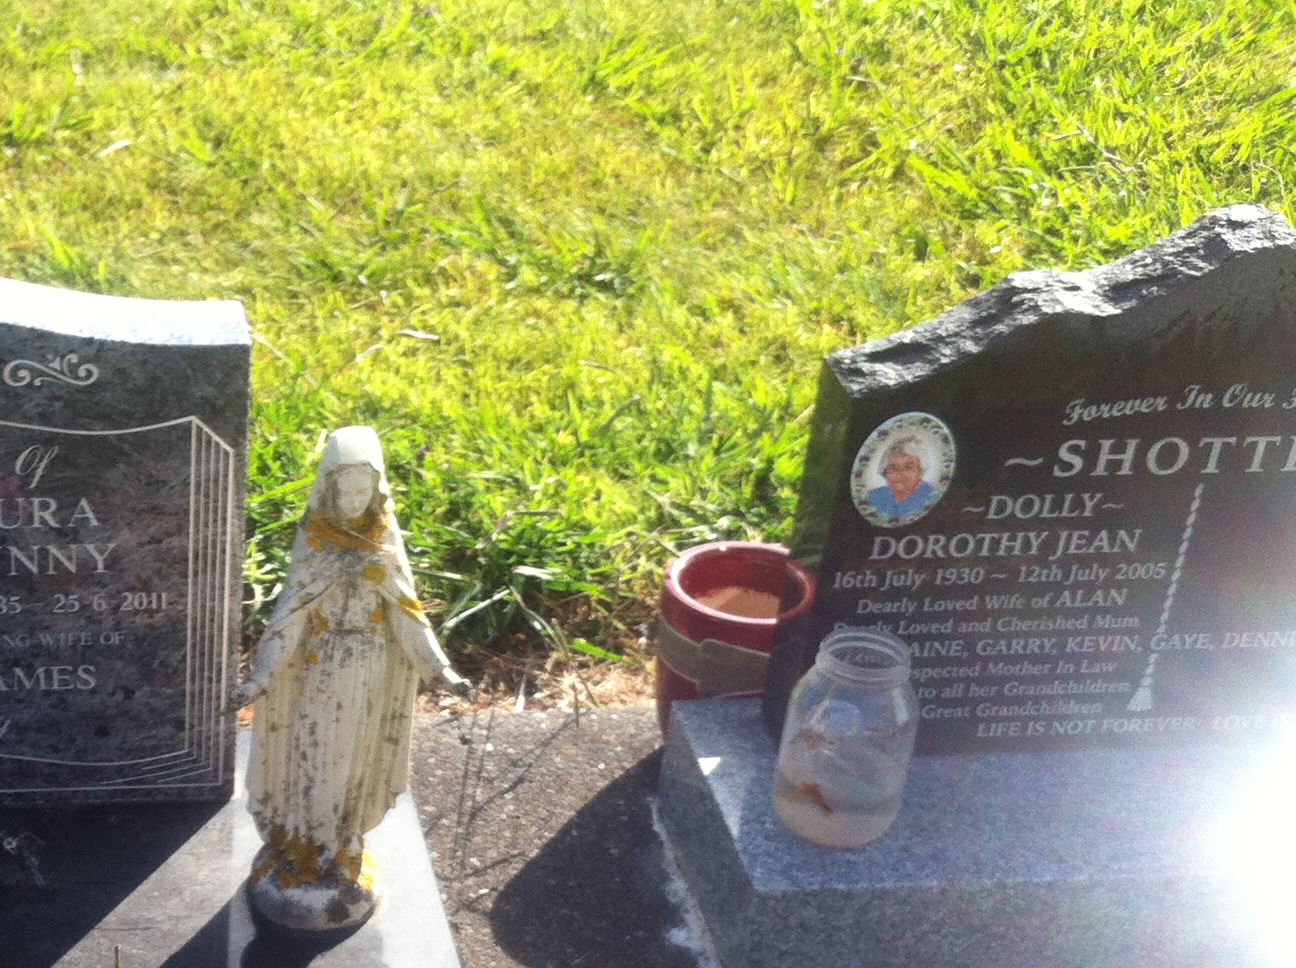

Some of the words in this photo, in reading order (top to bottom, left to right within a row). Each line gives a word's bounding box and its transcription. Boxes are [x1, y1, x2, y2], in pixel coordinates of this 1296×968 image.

[1062, 397, 1167, 426] Forever
[1176, 384, 1213, 410] In
[1222, 383, 1277, 409] Our
[15, 444, 59, 488] Of
[869, 531, 1049, 560] DOROTHY
[1048, 529, 1142, 560] JEAN
[832, 571, 877, 588] 16th
[879, 569, 925, 591] July
[934, 566, 984, 586] 1930
[1017, 565, 1063, 583] 12th
[1064, 562, 1110, 585] July
[1115, 562, 1167, 580] 2005
[857, 598, 918, 616] Dearly
[923, 595, 978, 611] Loved
[985, 593, 1024, 610] Wife
[1031, 591, 1054, 608] of
[1053, 588, 1128, 607] ALAN
[898, 618, 954, 634] Loved
[958, 617, 992, 634] and
[997, 615, 1088, 632] Cherished
[1092, 614, 1140, 629] Mum
[38, 632, 93, 646] WIFE
[99, 631, 125, 645] OF
[911, 666, 981, 683] spected
[985, 661, 1051, 677] Mother
[1080, 658, 1118, 674] Law
[969, 681, 999, 698] her
[1004, 678, 1130, 697] Grandchildren
[976, 700, 1102, 718] Grandchildren
[977, 721, 1022, 738] LIFE
[1026, 720, 1047, 737] IS
[1051, 718, 1097, 736] NOT
